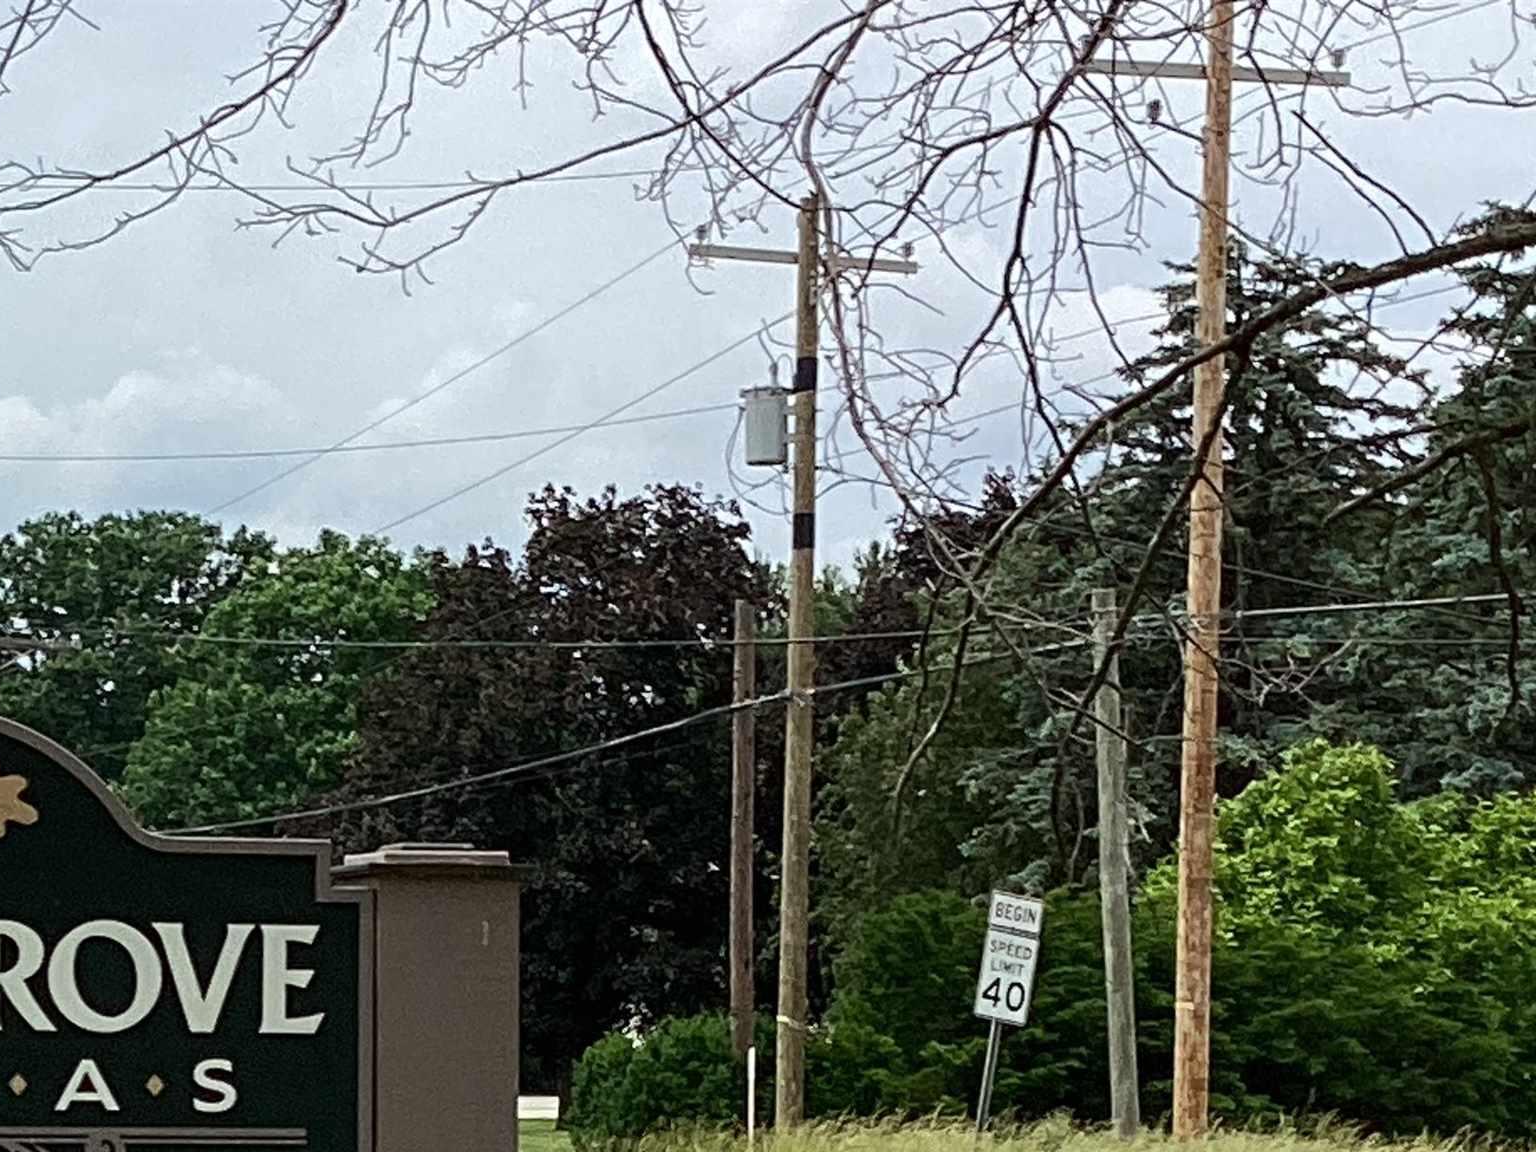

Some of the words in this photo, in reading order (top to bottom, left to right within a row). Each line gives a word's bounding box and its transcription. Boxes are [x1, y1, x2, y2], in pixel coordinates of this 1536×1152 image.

[995, 901, 1038, 925] BEGIN
[989, 939, 1033, 961] SPEED
[990, 959, 1026, 977] LIMIT
[981, 976, 1026, 1012] 40
